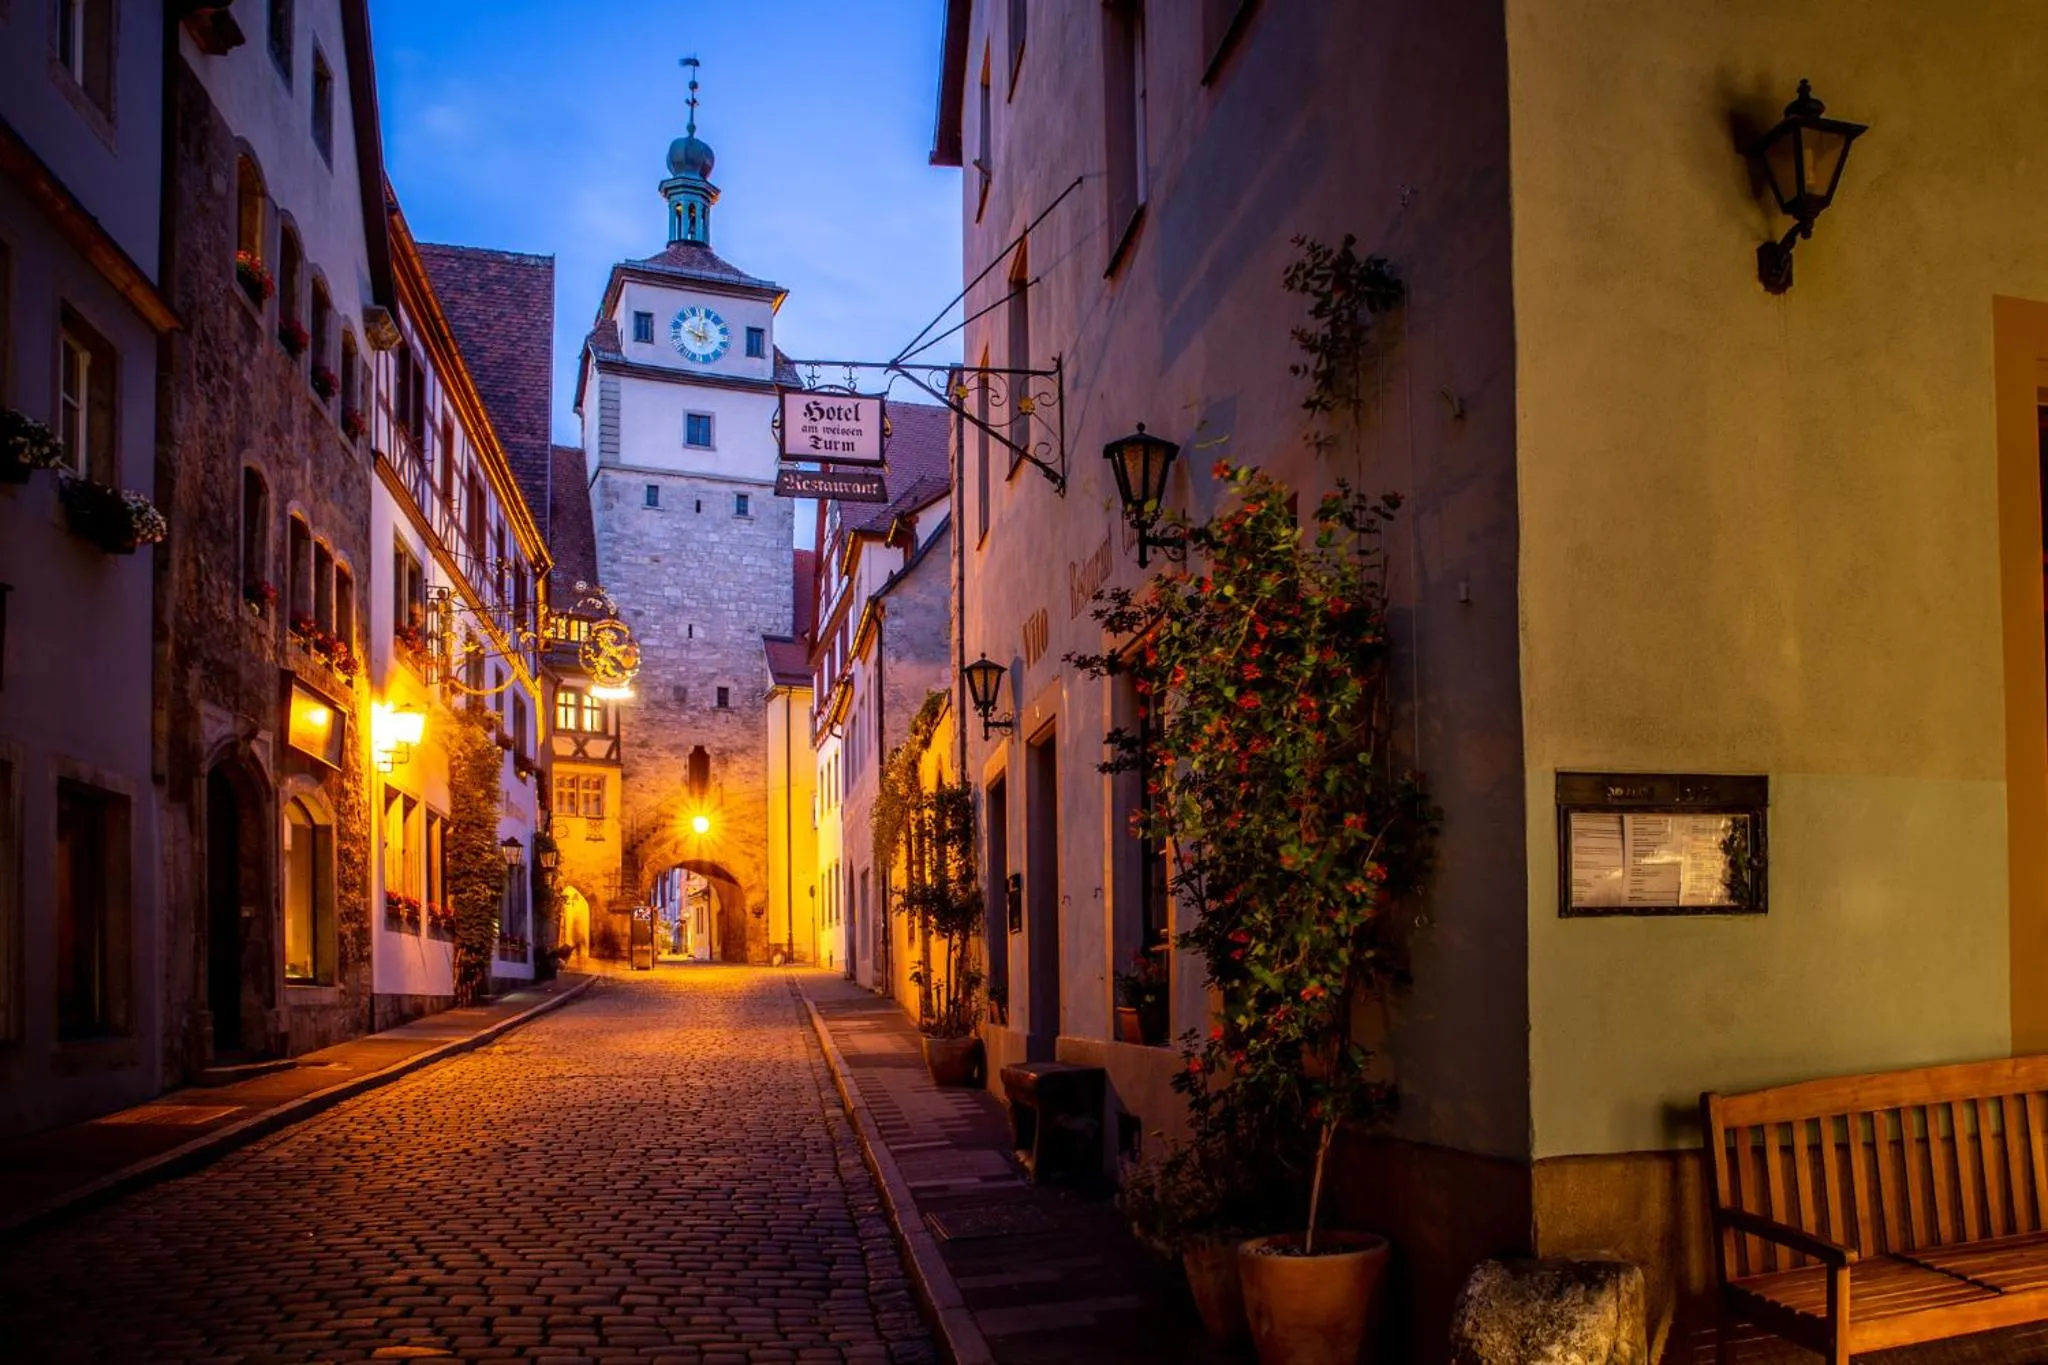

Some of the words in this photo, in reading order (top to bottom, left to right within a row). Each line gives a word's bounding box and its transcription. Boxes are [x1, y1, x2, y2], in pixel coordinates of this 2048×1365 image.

[803, 400, 862, 423] Hotel
[801, 425, 819, 434] am
[822, 425, 863, 437] weissen
[809, 435, 856, 453] Turm
[783, 473, 879, 495] Restaurant
